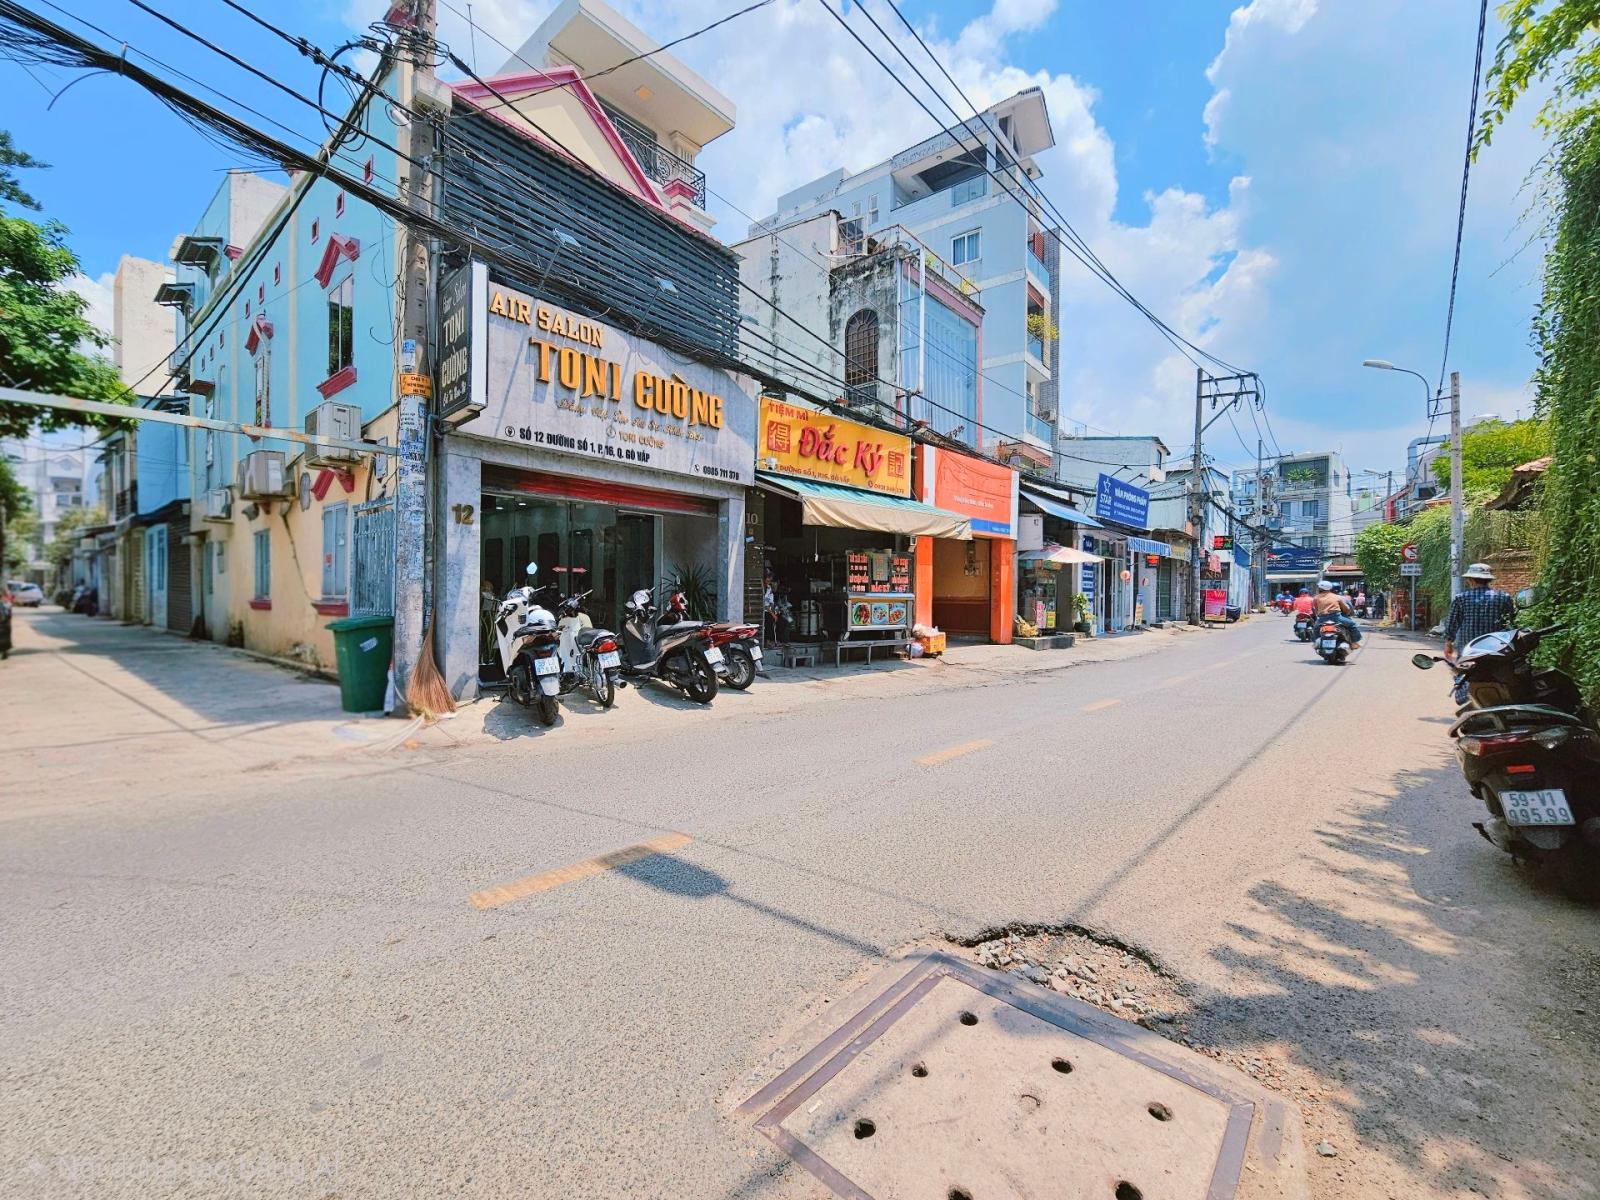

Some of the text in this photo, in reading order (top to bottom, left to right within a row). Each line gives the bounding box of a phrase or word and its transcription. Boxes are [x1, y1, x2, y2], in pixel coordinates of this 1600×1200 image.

[443, 307, 465, 348] TONI
[537, 306, 604, 348] SALON
[529, 336, 621, 402] TONI
[634, 370, 725, 430] CƯỜNG
[768, 400, 808, 421] TIỆM MÌ
[534, 431, 544, 443] 12
[590, 443, 596, 454] 1,
[768, 420, 790, 454] 得
[799, 424, 848, 466] Đắc
[452, 503, 474, 525] 12
[745, 512, 758, 525] 10
